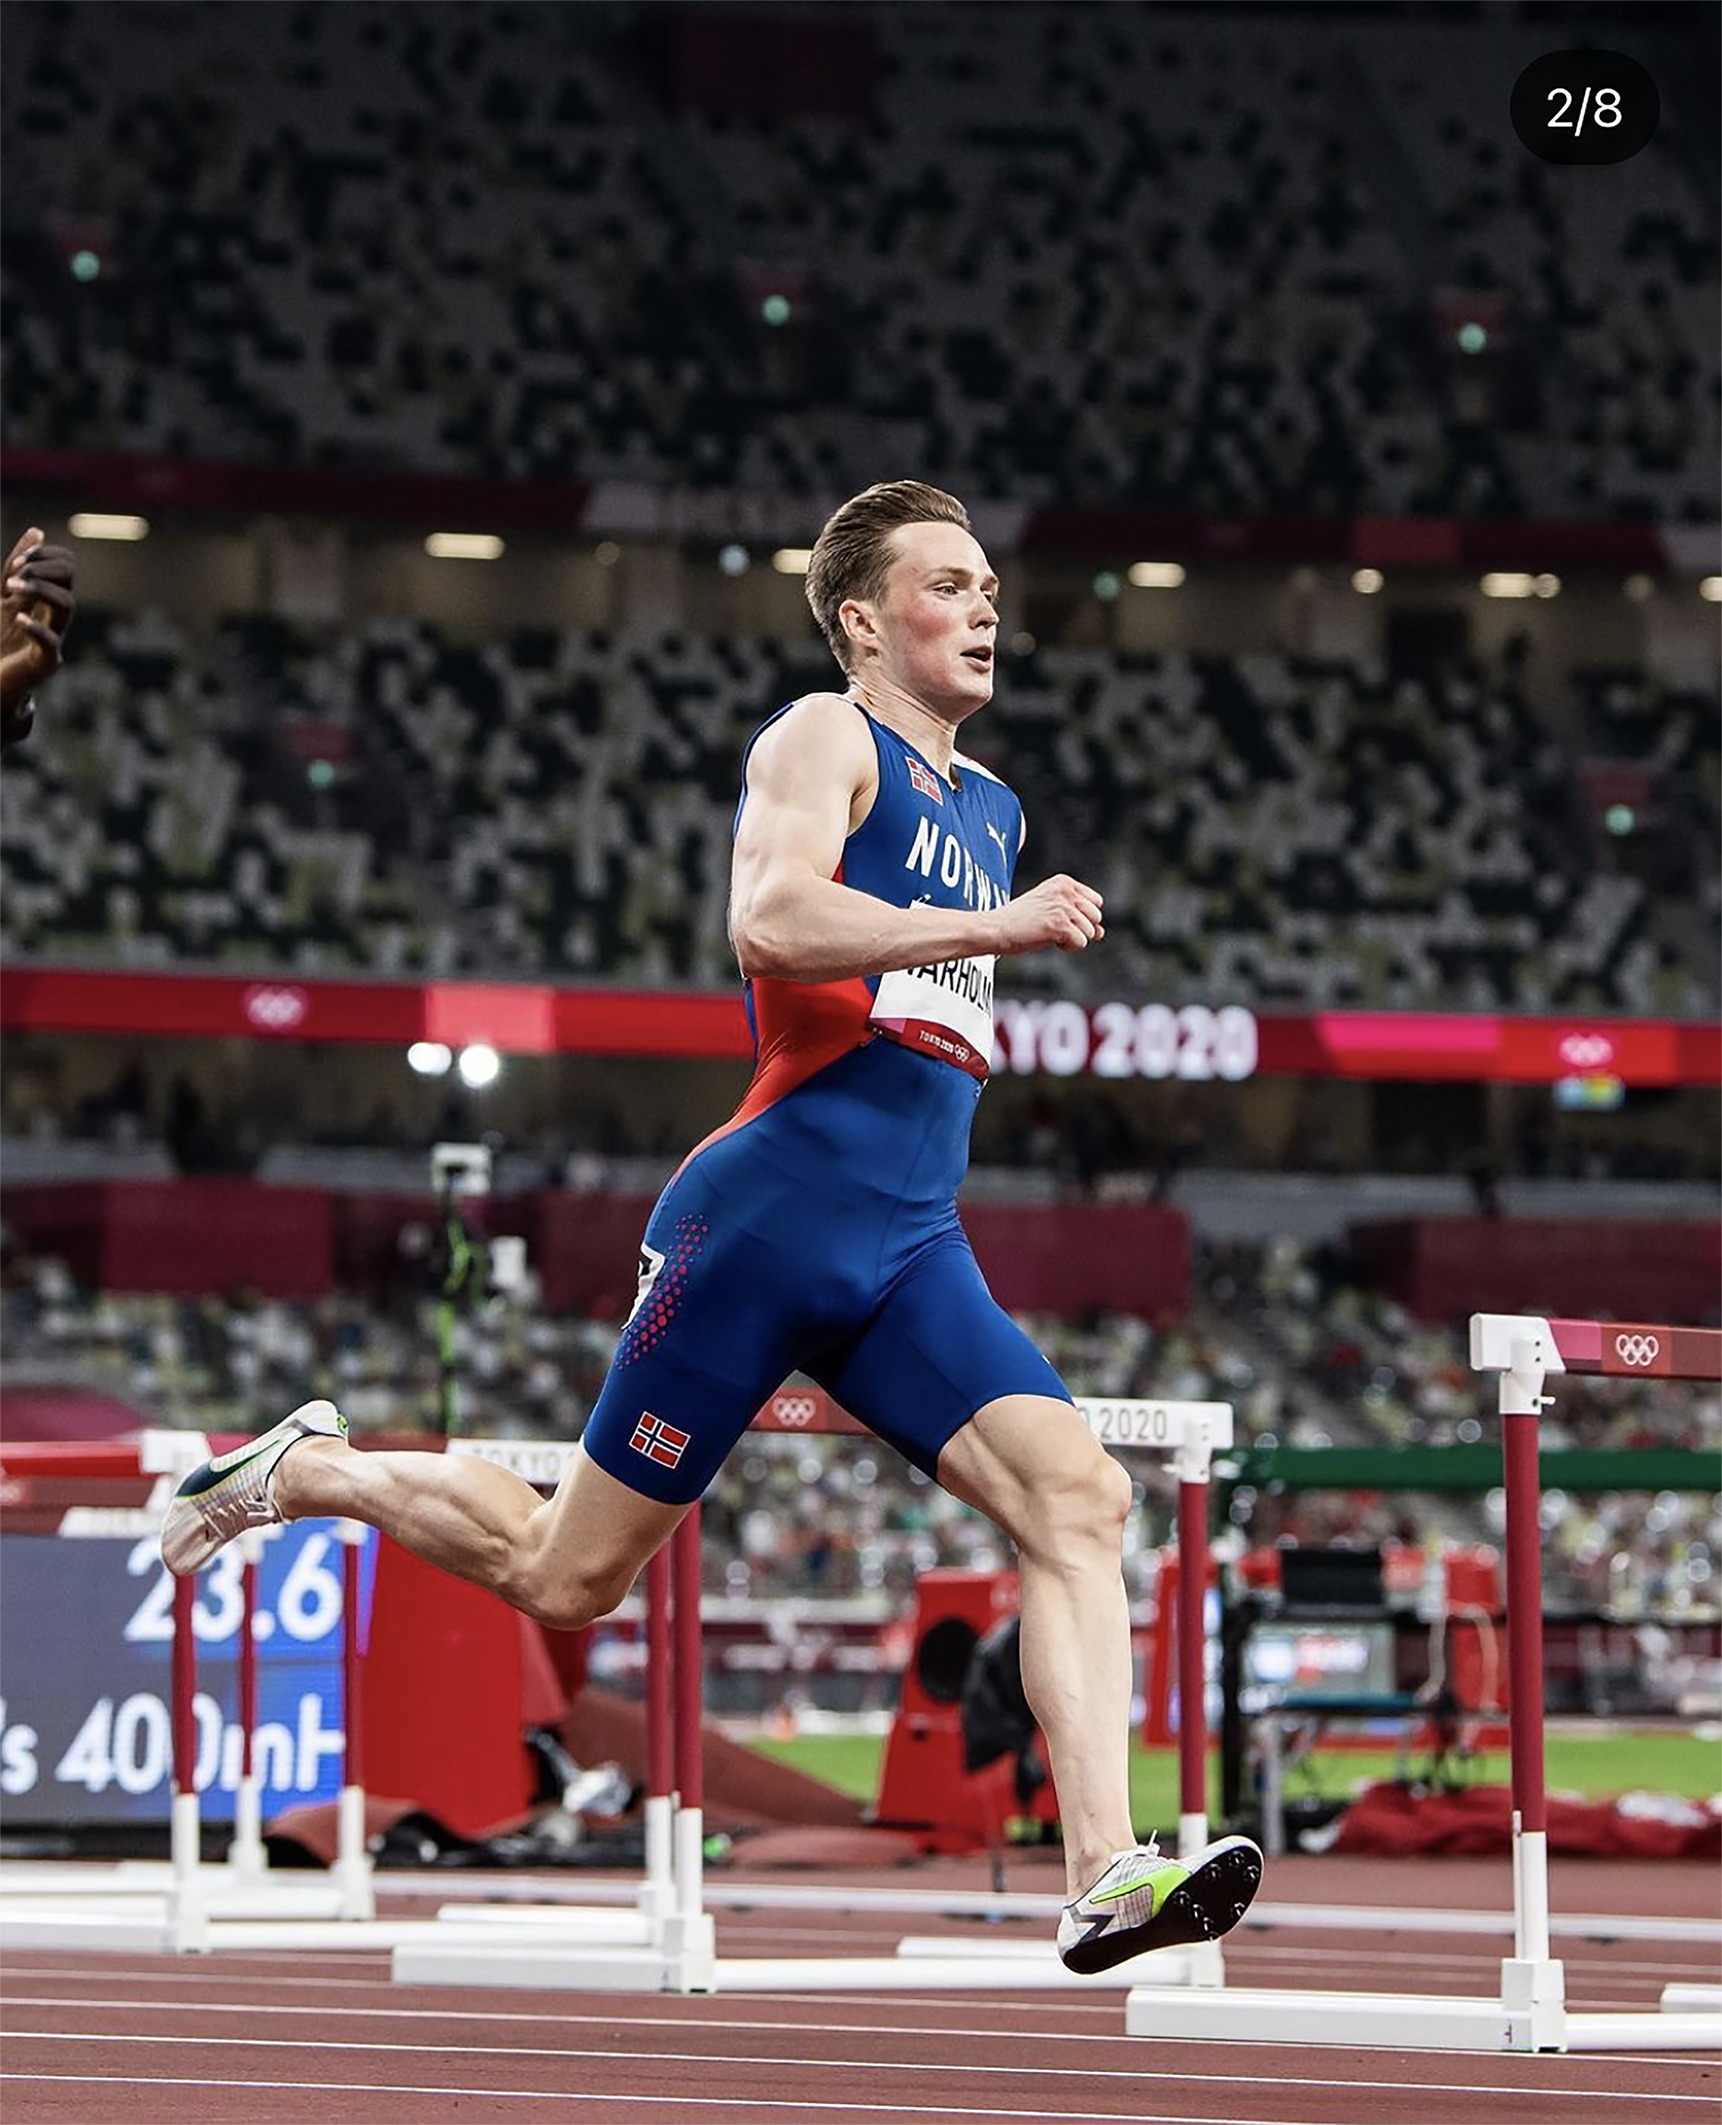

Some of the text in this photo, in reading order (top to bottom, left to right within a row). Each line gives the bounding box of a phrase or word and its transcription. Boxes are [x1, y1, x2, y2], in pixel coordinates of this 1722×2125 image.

[907, 959, 992, 1018] ARHOLM
[992, 999, 1259, 1082] YO 2020
[1098, 1406, 1168, 1441] 2020
[123, 1532, 344, 1643] 23.6
